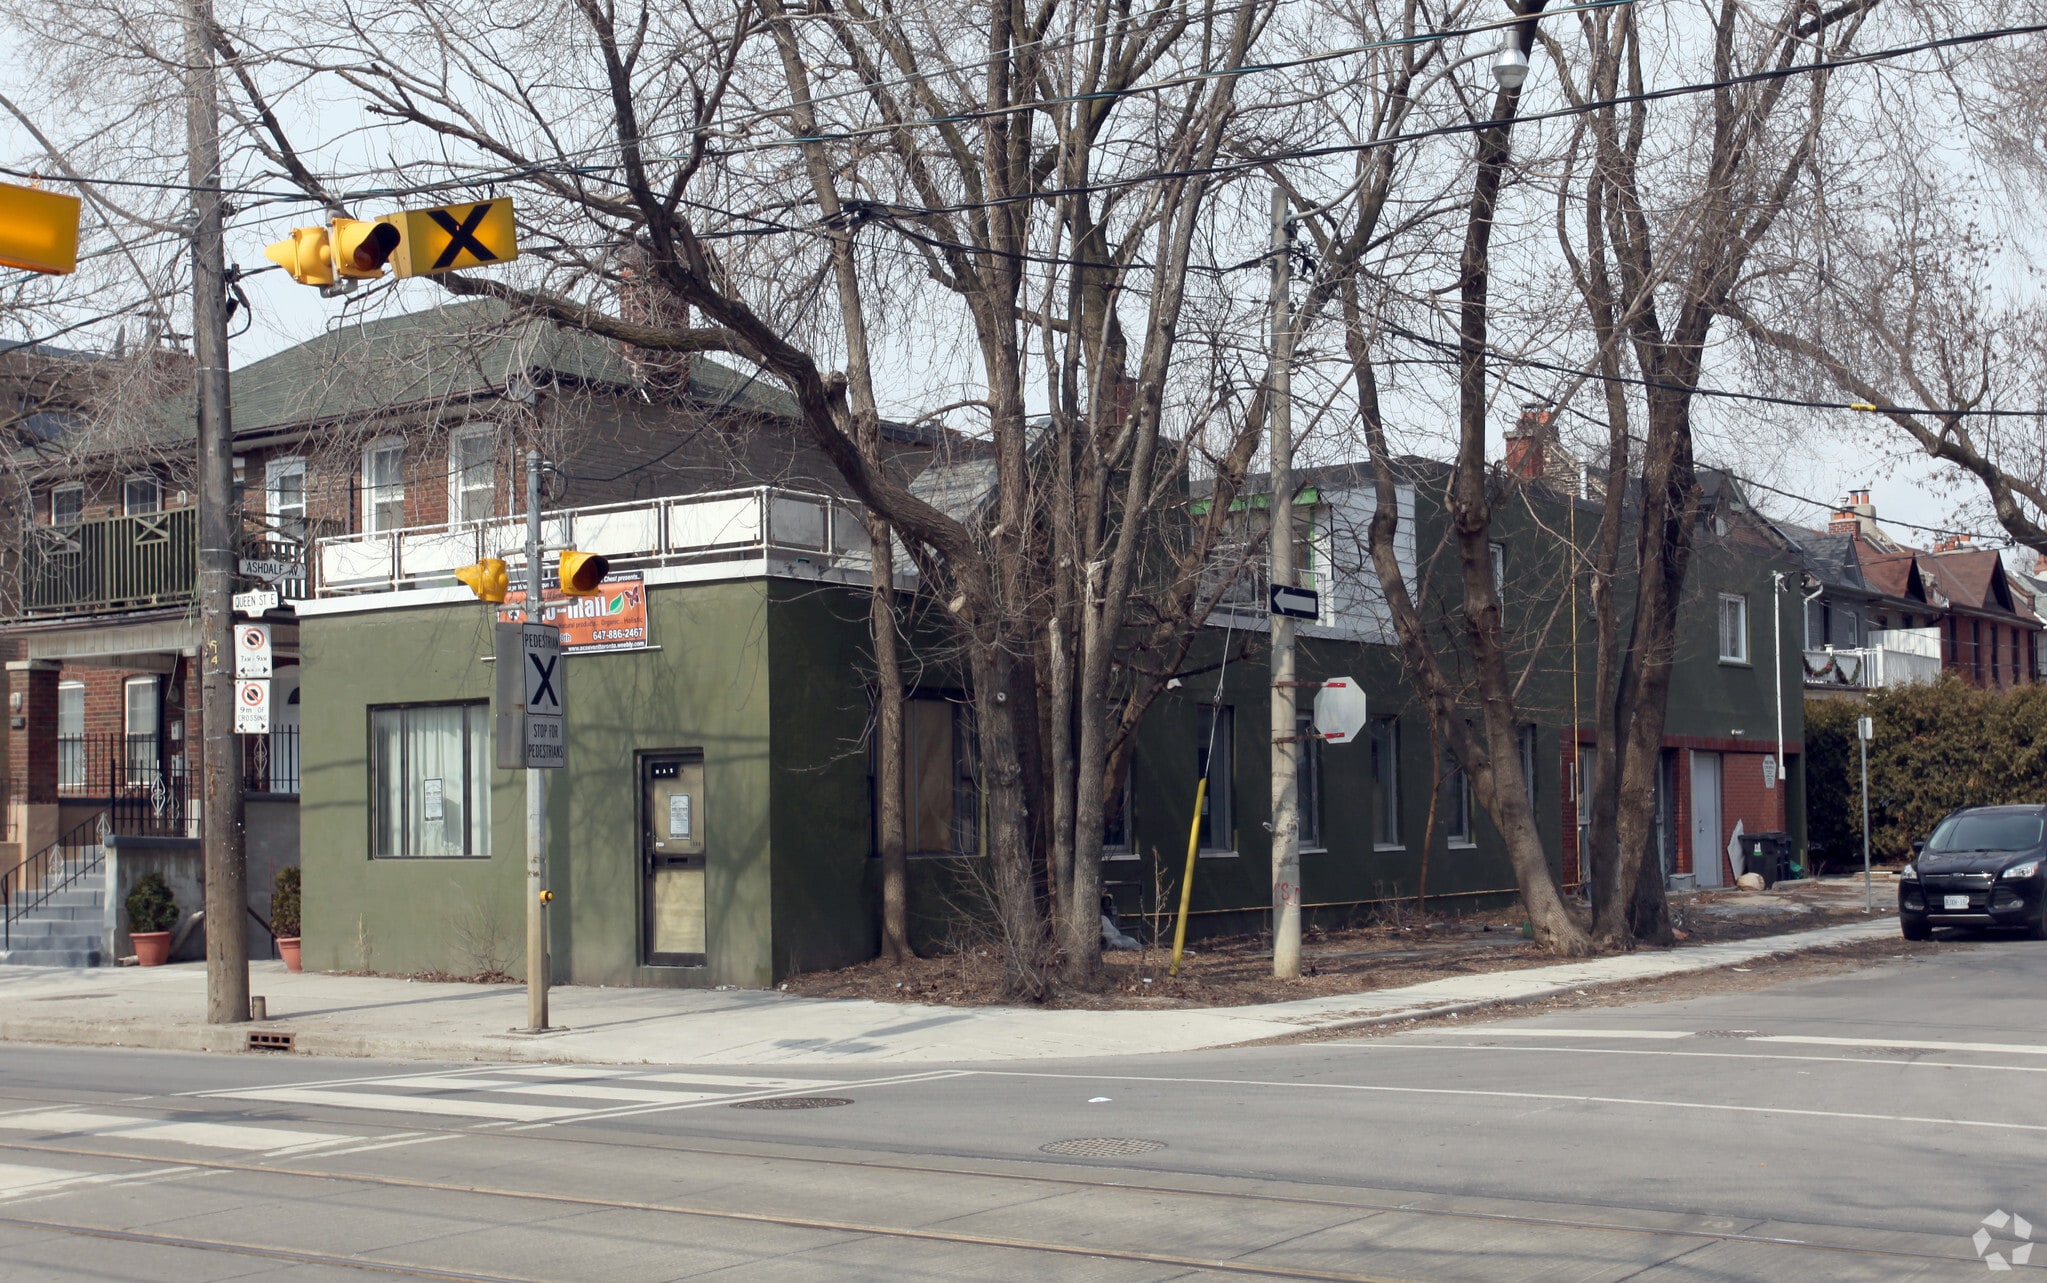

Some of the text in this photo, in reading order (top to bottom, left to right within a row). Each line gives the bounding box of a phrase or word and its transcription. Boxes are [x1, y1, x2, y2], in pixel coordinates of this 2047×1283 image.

[235, 593, 276, 608] QUEEN ST E
[592, 627, 644, 641] 647-886-2467
[524, 633, 559, 650] PEDESTRIAN
[238, 714, 267, 722] CROSSING
[533, 724, 558, 738] STOP FOR
[528, 743, 564, 759] PEDESTRIANS
